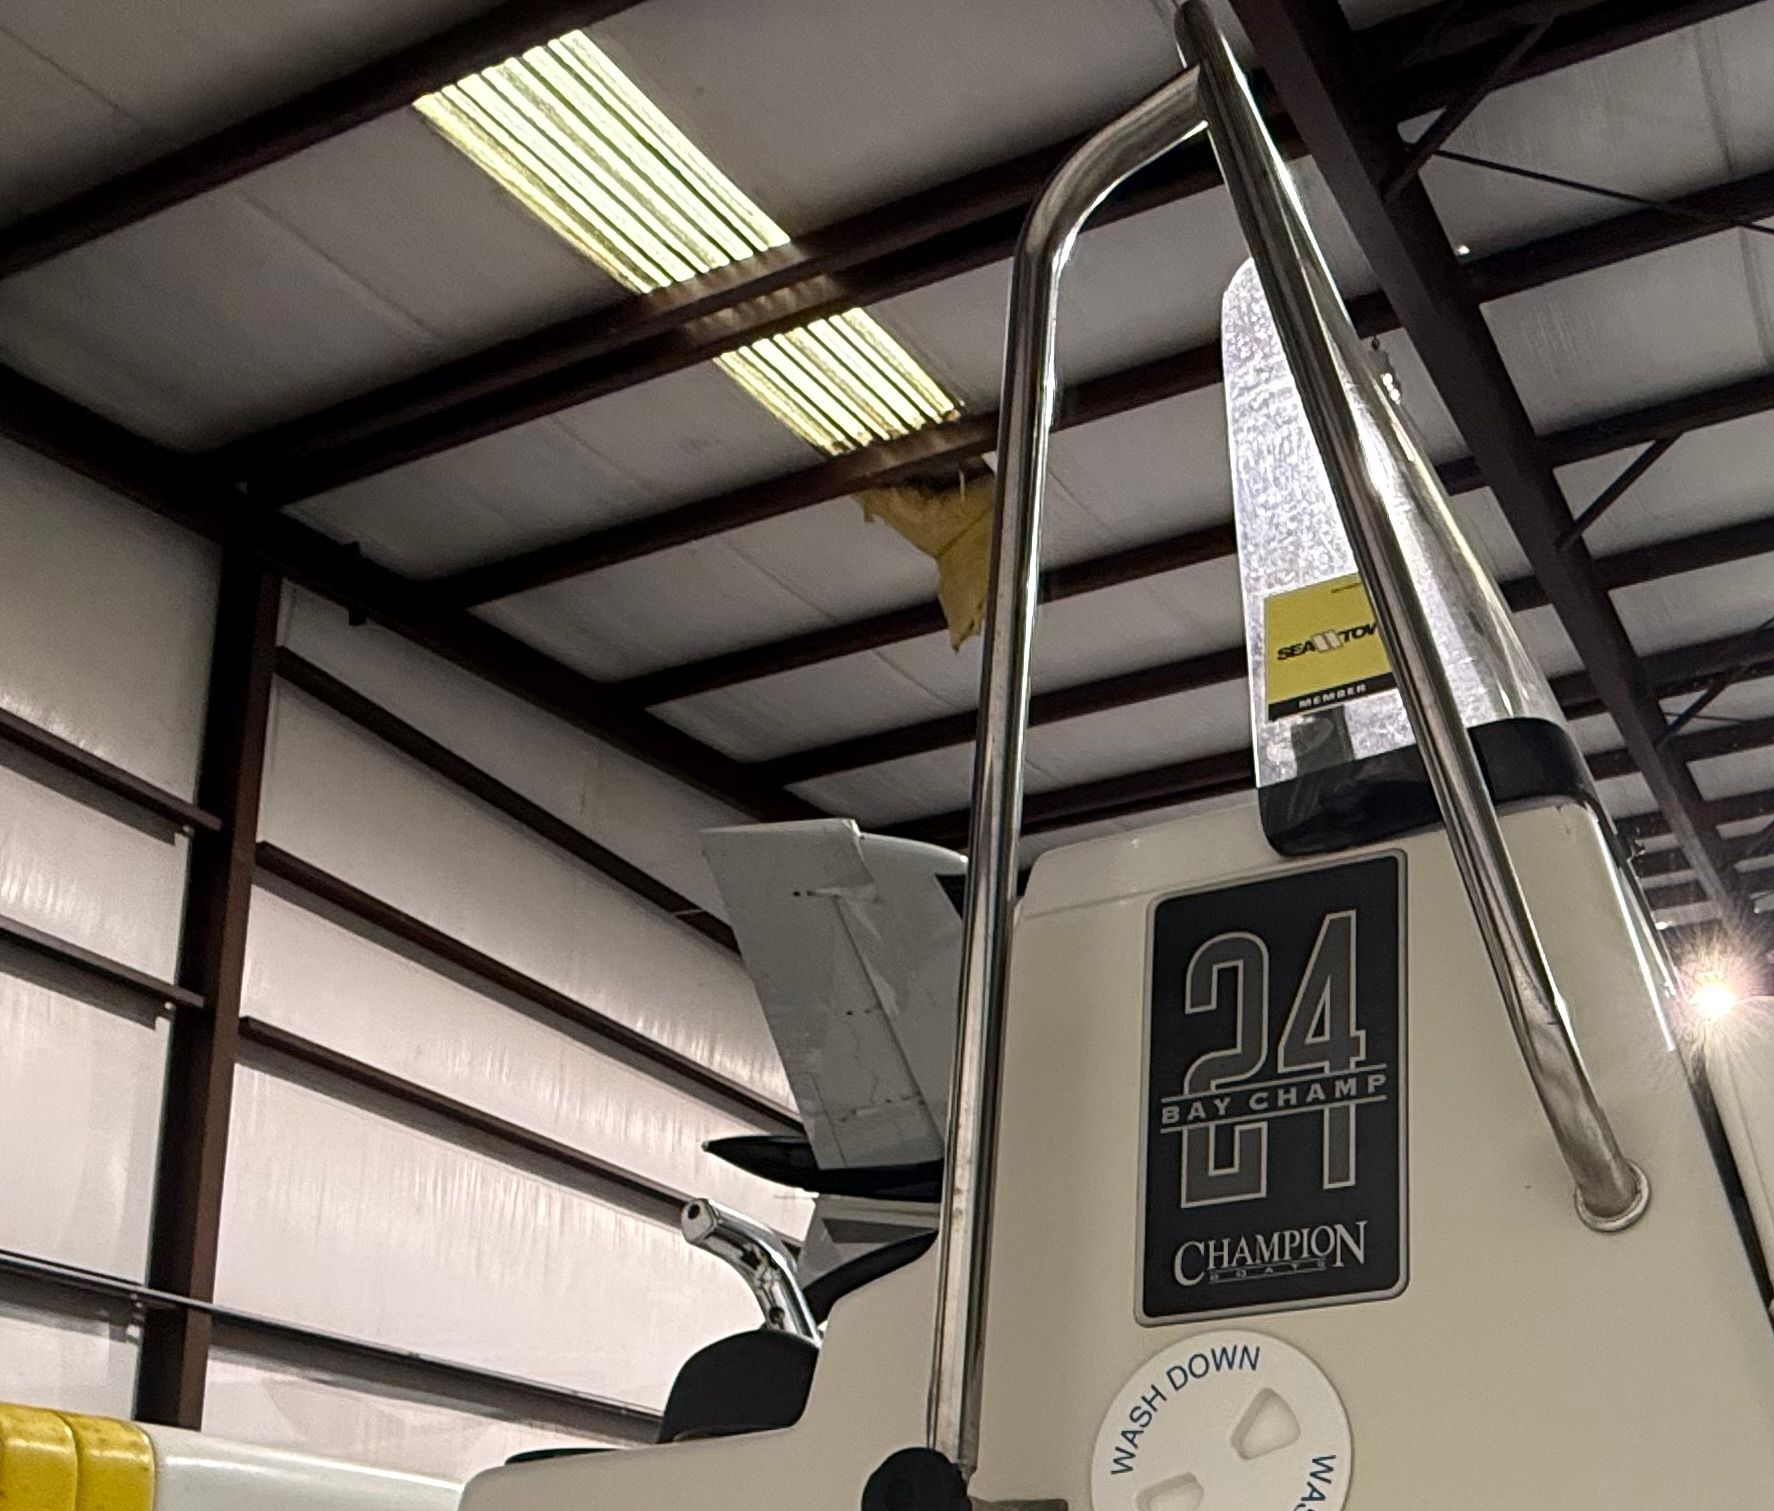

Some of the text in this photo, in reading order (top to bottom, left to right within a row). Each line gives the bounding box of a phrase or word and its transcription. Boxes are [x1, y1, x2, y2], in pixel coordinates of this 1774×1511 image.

[1277, 640, 1316, 661] SEA
[1298, 683, 1366, 709] MEMBER
[1181, 909, 1366, 1208] 24
[1161, 1074, 1388, 1125] BAY CHAMP
[1174, 1220, 1369, 1287] CHAMPION
[1110, 1345, 1261, 1475] WASH DOWN
